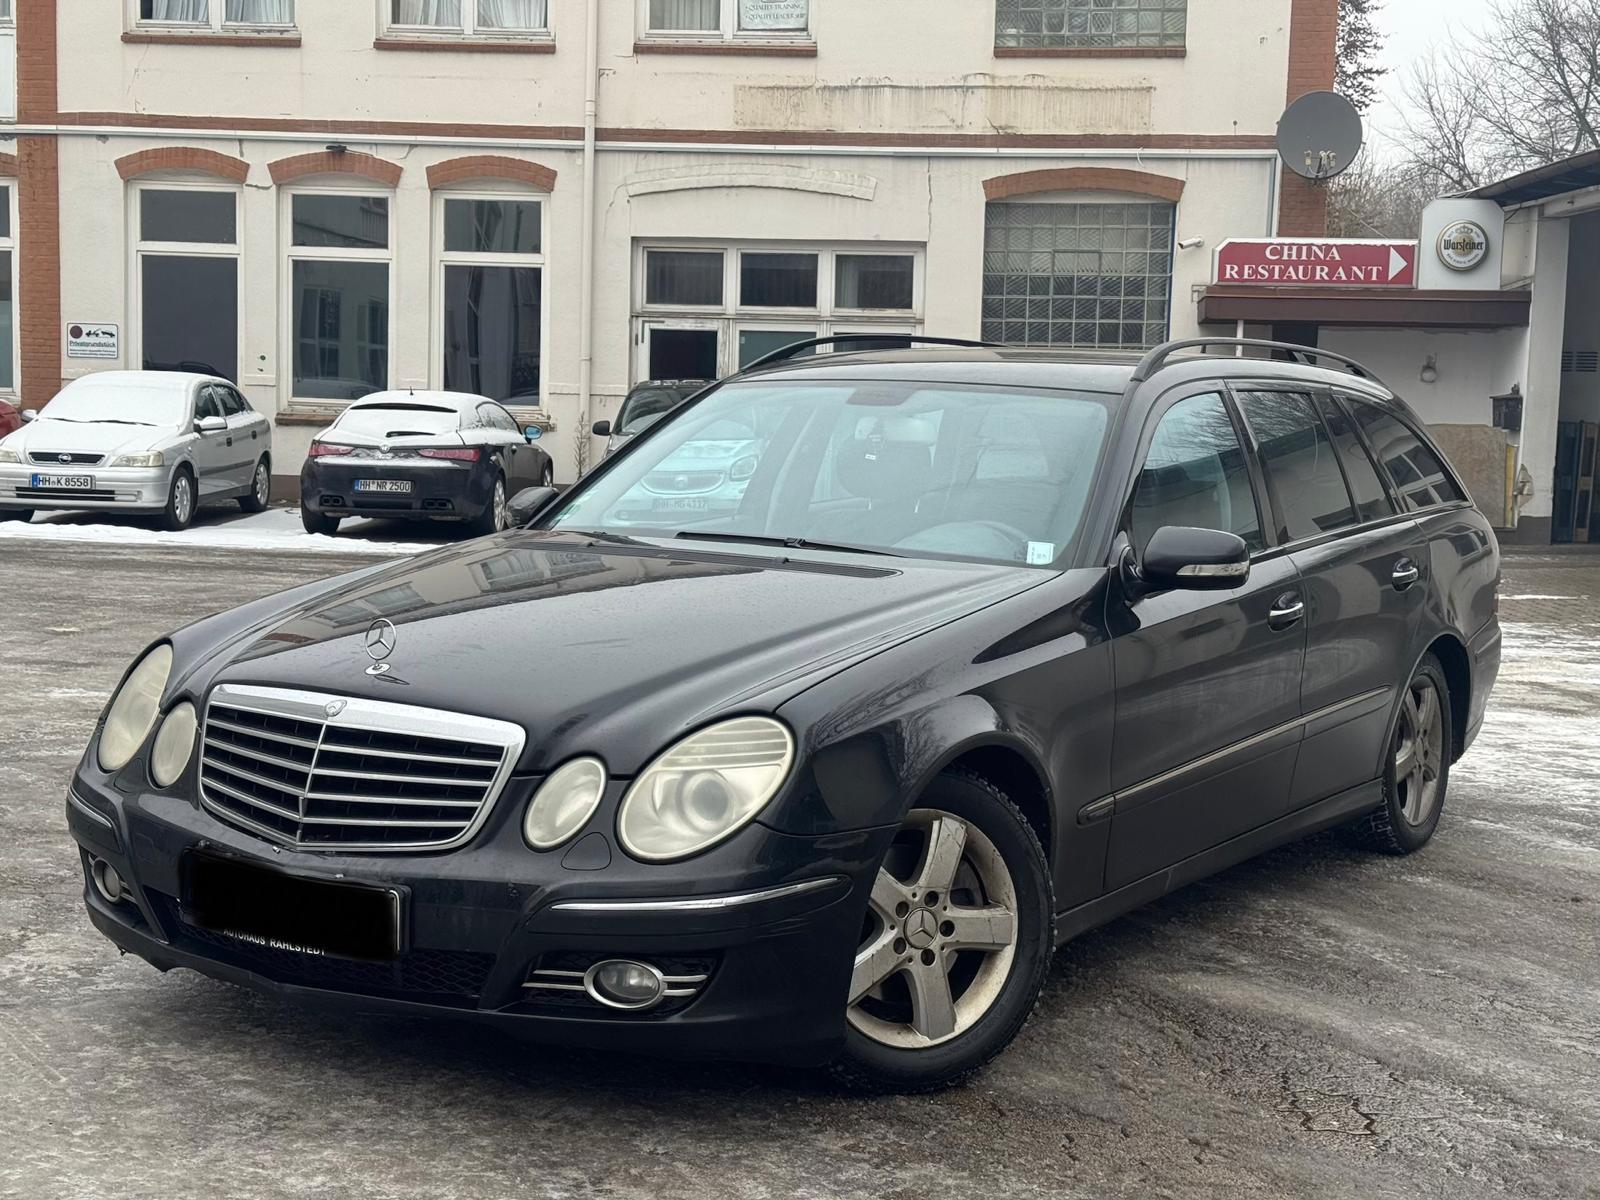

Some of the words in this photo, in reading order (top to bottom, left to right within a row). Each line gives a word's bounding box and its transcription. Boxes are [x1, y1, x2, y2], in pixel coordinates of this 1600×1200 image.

[1443, 238, 1485, 251] Warsteiner
[1265, 245, 1342, 261] CHINA
[1224, 264, 1383, 281] RESTAURANT
[38, 476, 51, 486] HH
[64, 477, 89, 487] 8558
[360, 480, 371, 490] HH
[389, 481, 410, 491] 2500
